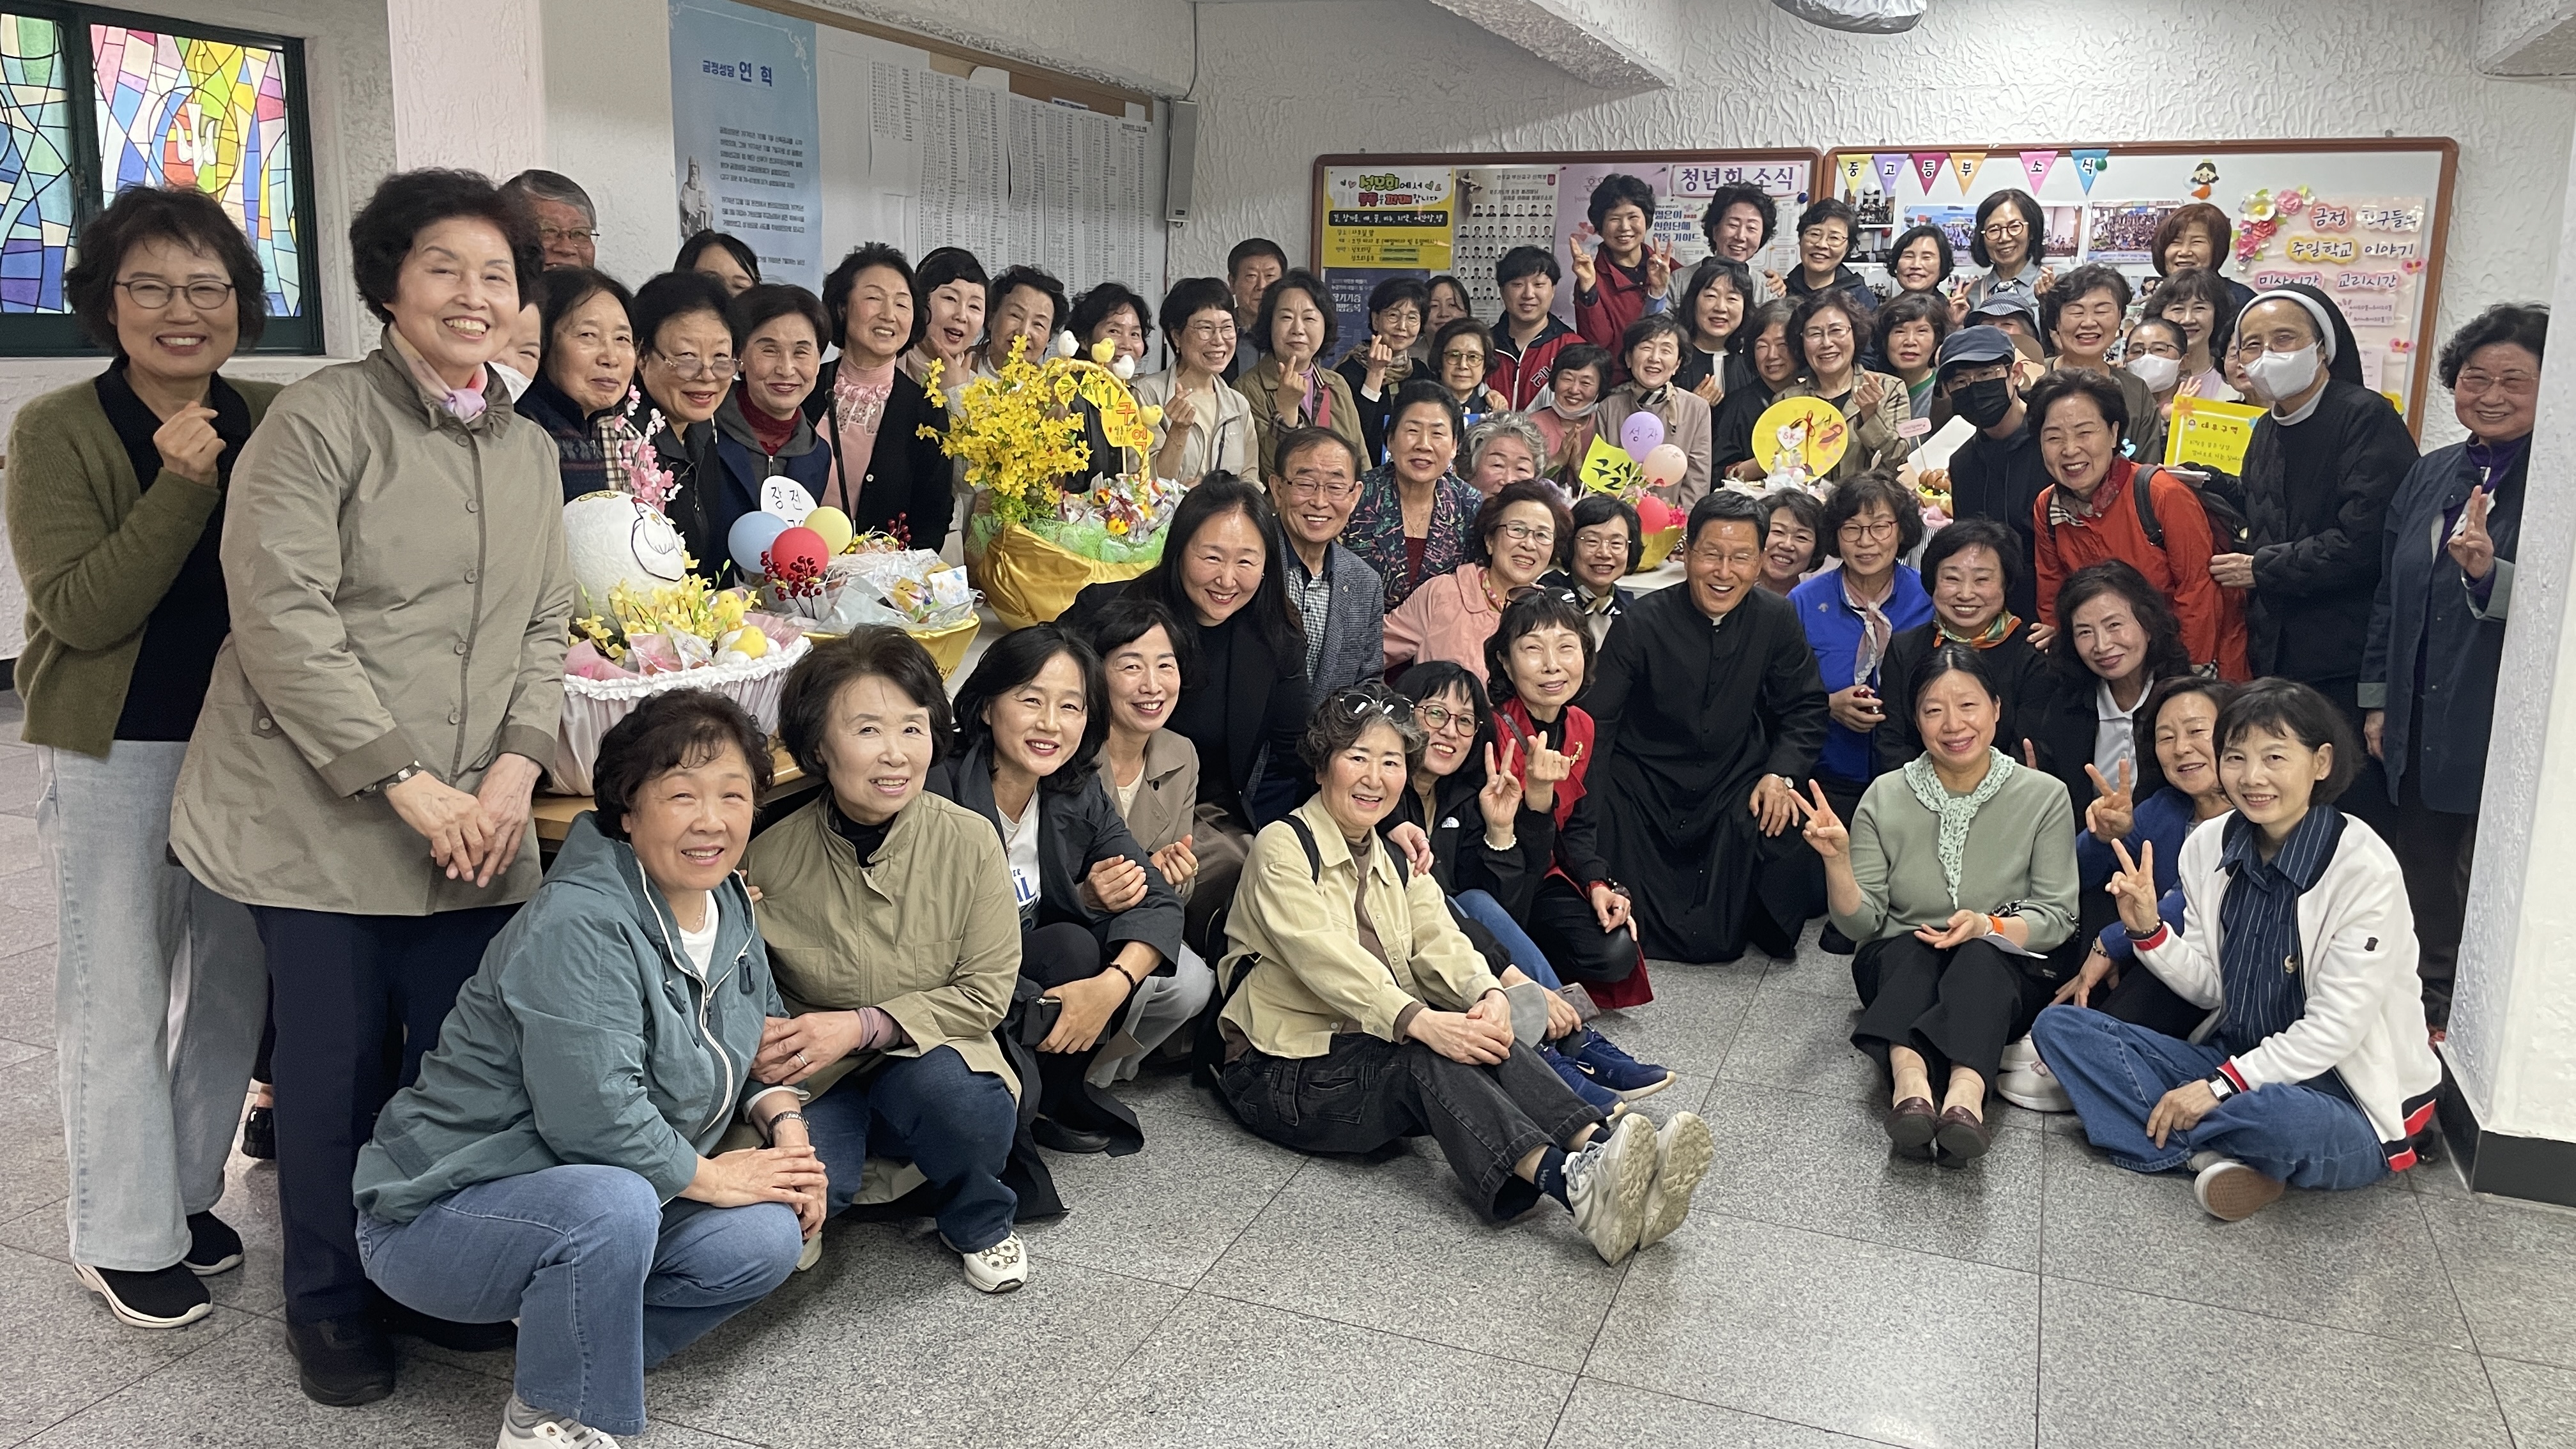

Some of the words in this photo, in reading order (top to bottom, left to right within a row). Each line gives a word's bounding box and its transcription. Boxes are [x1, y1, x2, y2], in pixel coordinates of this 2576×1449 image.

[703, 60, 734, 77] 금정성당
[1359, 173, 1422, 192] 성모회에서
[1680, 167, 1743, 192] 청년회
[1753, 167, 1793, 190] 소식
[2313, 208, 2346, 227] 금정
[2361, 210, 2418, 227] 친구들의
[2291, 241, 2352, 257] 주일학교
[2365, 243, 2414, 256] 이야기
[2338, 273, 2396, 288] 교리시간
